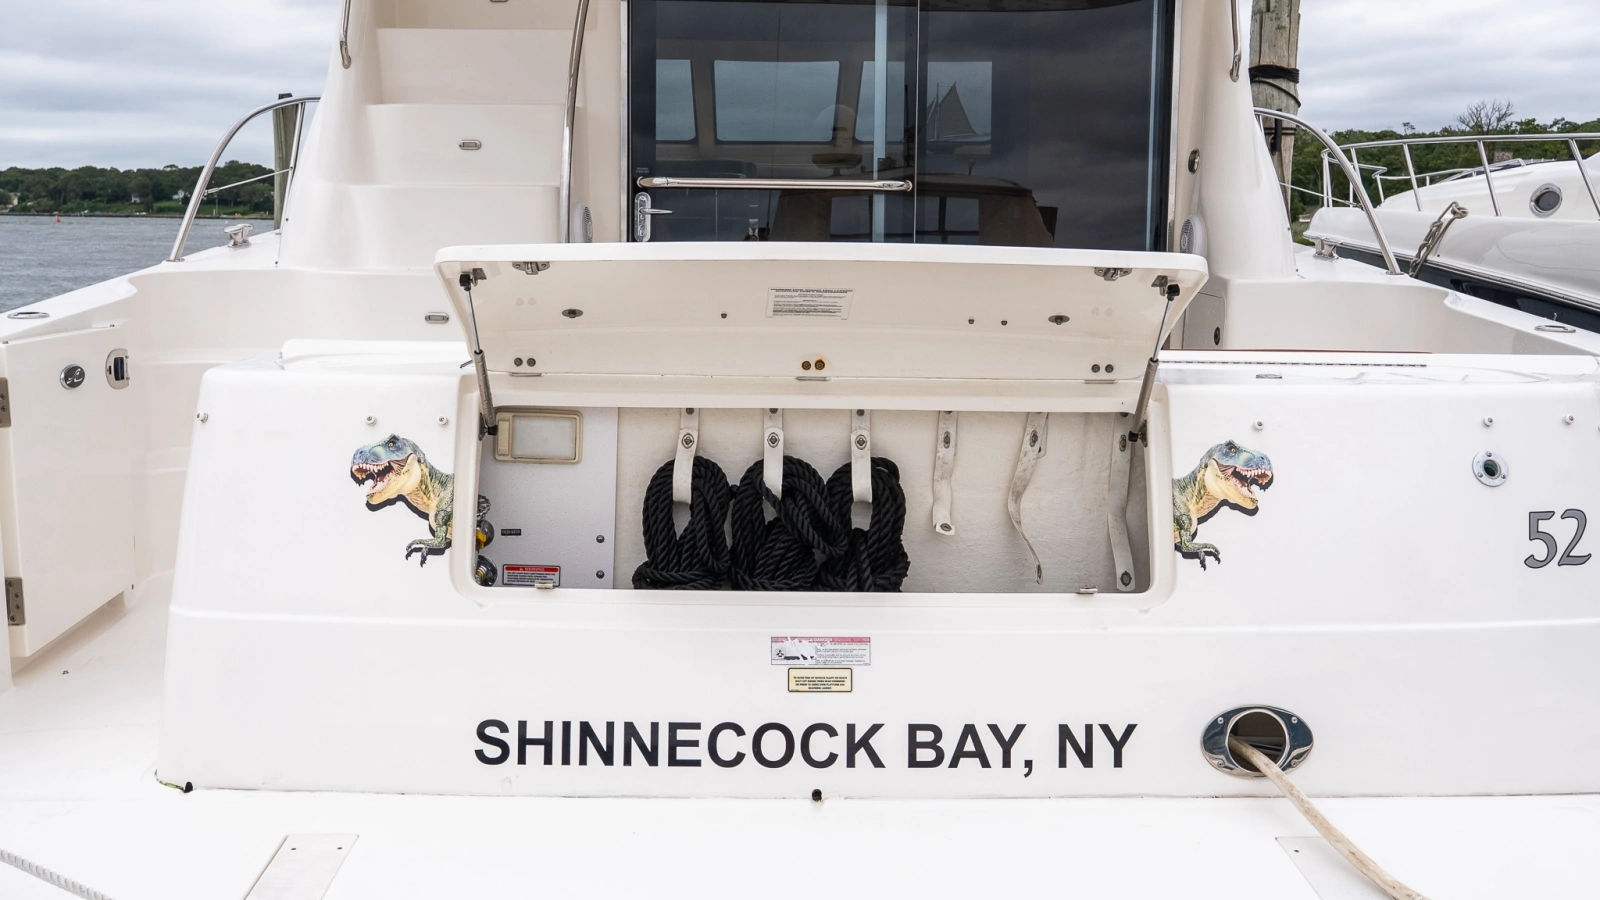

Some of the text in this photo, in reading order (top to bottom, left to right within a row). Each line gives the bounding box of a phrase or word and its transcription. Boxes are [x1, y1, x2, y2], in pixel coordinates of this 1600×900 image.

[1523, 508, 1592, 569] 52
[474, 719, 1138, 778] SHINNECOCK BAY, NY
